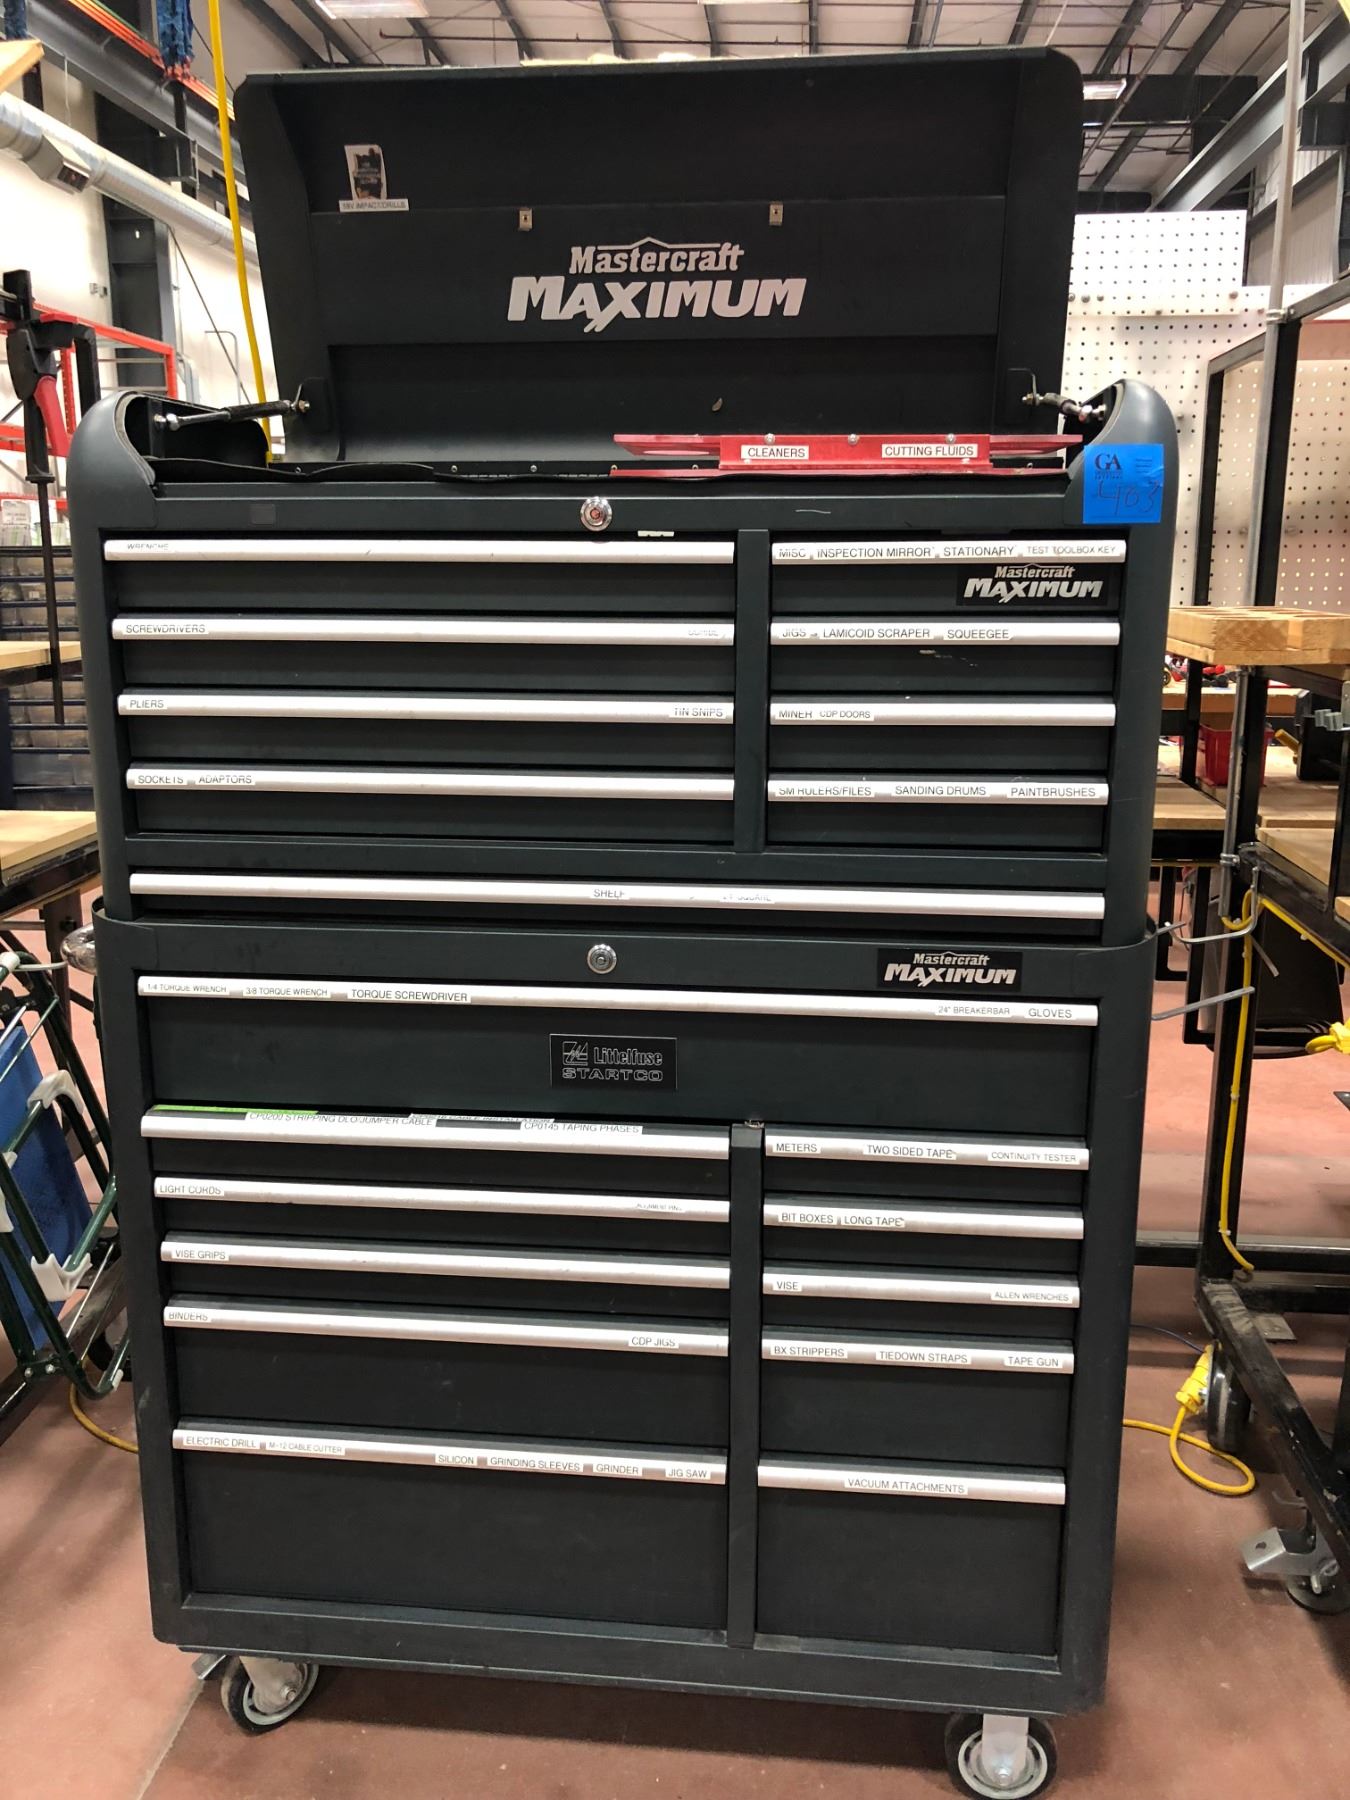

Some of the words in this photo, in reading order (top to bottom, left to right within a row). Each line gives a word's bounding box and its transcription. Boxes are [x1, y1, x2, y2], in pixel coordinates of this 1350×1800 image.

[569, 240, 744, 274] Mastercraft
[507, 276, 807, 333] MAXIMUM
[747, 447, 806, 458] CLEANERS
[884, 446, 933, 456] CUTTING
[936, 446, 974, 456] FLUIDS
[1094, 453, 1122, 470] GA
[817, 547, 883, 558] INSPECTION
[886, 547, 931, 558] MIRROR
[943, 546, 1015, 557] STATIONARY
[1027, 546, 1049, 555] TEST
[1053, 545, 1095, 555] TOOLBOX
[1098, 545, 1116, 554] KEY
[994, 564, 1076, 579] Mastercraft
[963, 578, 1104, 603] MAXIMUM
[126, 624, 206, 634] SCREWDRIVERS
[782, 628, 807, 638] JIGS
[823, 628, 875, 638] LAMICOID
[877, 628, 931, 638] SCRAPER
[947, 629, 1009, 639] SQUEEGEE
[129, 699, 165, 709] PLIERS
[691, 707, 724, 718] SNIPS
[839, 710, 871, 719] DOORS
[137, 774, 184, 784] SOCKETS
[198, 774, 253, 784] ADAPTORS
[797, 786, 872, 796] RULERS/FILES
[895, 785, 944, 795] SANDING
[946, 786, 987, 796] DRUMS
[1010, 787, 1096, 797] PAINTBRUSHES
[593, 888, 625, 899] SHELF
[912, 951, 990, 966] Mastercraft
[883, 963, 1017, 987] MAXIMUM
[193, 985, 227, 993] WRENCH
[259, 987, 291, 996] TORQUE
[293, 988, 328, 996] WRENCH
[351, 989, 393, 999] TORQUE
[394, 990, 468, 1002] SCREWDRIVER
[953, 1006, 1011, 1015] BREAKERBAR
[1028, 1007, 1073, 1018] GLOVES
[593, 1046, 663, 1066] Littelfuse
[561, 1067, 664, 1082] STARTCO
[285, 1113, 336, 1123] STRIPPING
[359, 1116, 400, 1125] JUMPER
[401, 1117, 433, 1126] CABLE
[561, 1123, 598, 1132] TAPING
[599, 1124, 640, 1134] PHASES
[775, 1142, 818, 1153] METERS
[867, 1144, 890, 1155] TWO
[892, 1146, 924, 1157] SIDED
[925, 1148, 954, 1159] TAPE
[991, 1151, 1041, 1161] CONTINUITY
[1042, 1153, 1077, 1163] TESTER
[159, 1184, 186, 1194] LIGHT
[187, 1185, 222, 1195] CORDS
[781, 1212, 797, 1221] BIT
[799, 1213, 834, 1223] BOXES
[844, 1215, 873, 1225] LONG
[875, 1216, 904, 1227] TAPE
[175, 1249, 196, 1259] VISE
[197, 1250, 226, 1260] GRIPS
[776, 1280, 799, 1291] VISE
[994, 1291, 1020, 1300] ALLEN
[1022, 1292, 1070, 1302] WRENCHES
[168, 1311, 209, 1322] BINDERS
[654, 1337, 676, 1347] JIGS
[774, 1345, 787, 1355] BX
[789, 1346, 845, 1358] STRIPPERS
[879, 1350, 926, 1361] TIEDOWN
[928, 1352, 968, 1363] STRAPS
[1007, 1356, 1034, 1366] TAPE
[1036, 1357, 1060, 1367] GUN
[185, 1436, 230, 1447] ELECTRIC
[231, 1438, 257, 1449] DRILL
[288, 1443, 312, 1451] CABLE
[438, 1454, 474, 1465] SILICON
[490, 1456, 536, 1468] GRINDING
[537, 1459, 581, 1472] SLEEVES
[595, 1463, 639, 1475] GRINDER
[668, 1467, 684, 1477] JIG
[685, 1468, 708, 1479] SAW
[848, 1478, 890, 1489] VACUUM
[891, 1480, 966, 1494] ATTACHMENTS
